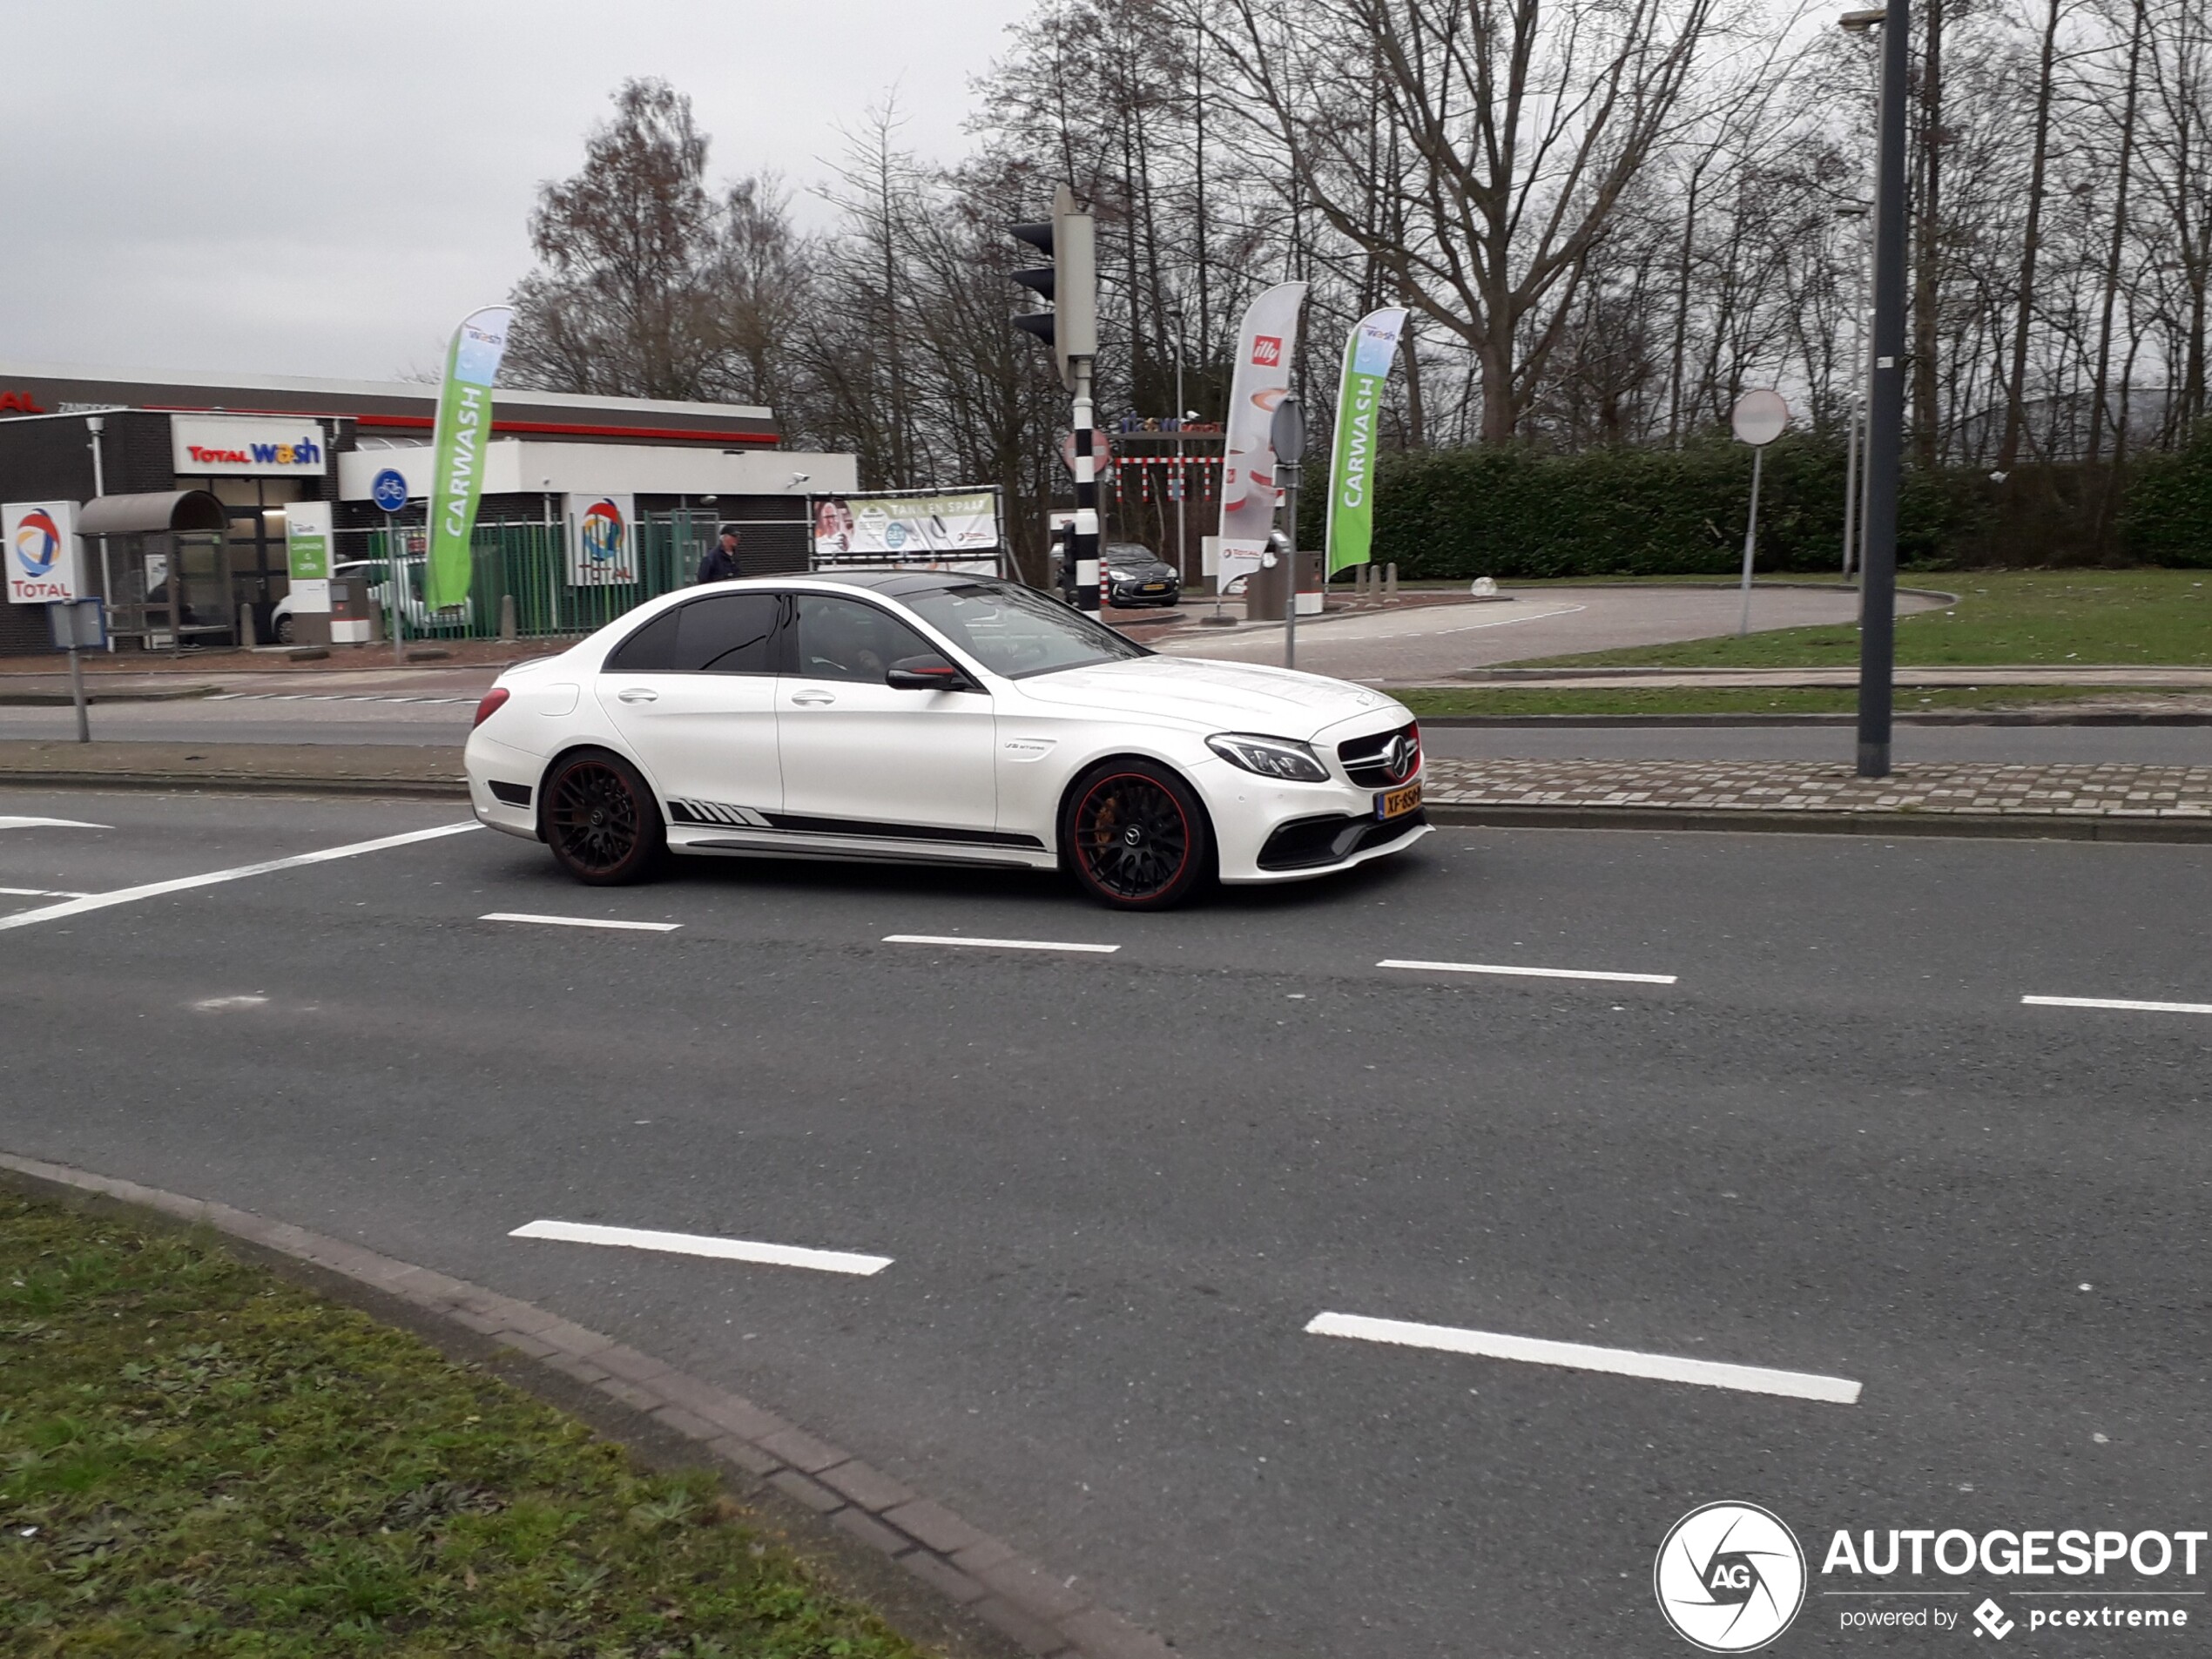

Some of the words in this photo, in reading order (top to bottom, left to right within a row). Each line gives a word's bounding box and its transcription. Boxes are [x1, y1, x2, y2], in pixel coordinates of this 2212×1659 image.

[1255, 341, 1278, 363] illy
[1344, 378, 1374, 507] CARWASH
[186, 445, 253, 463] TOTAL
[446, 387, 482, 537] CARWASH
[11, 580, 71, 597] TOTAL
